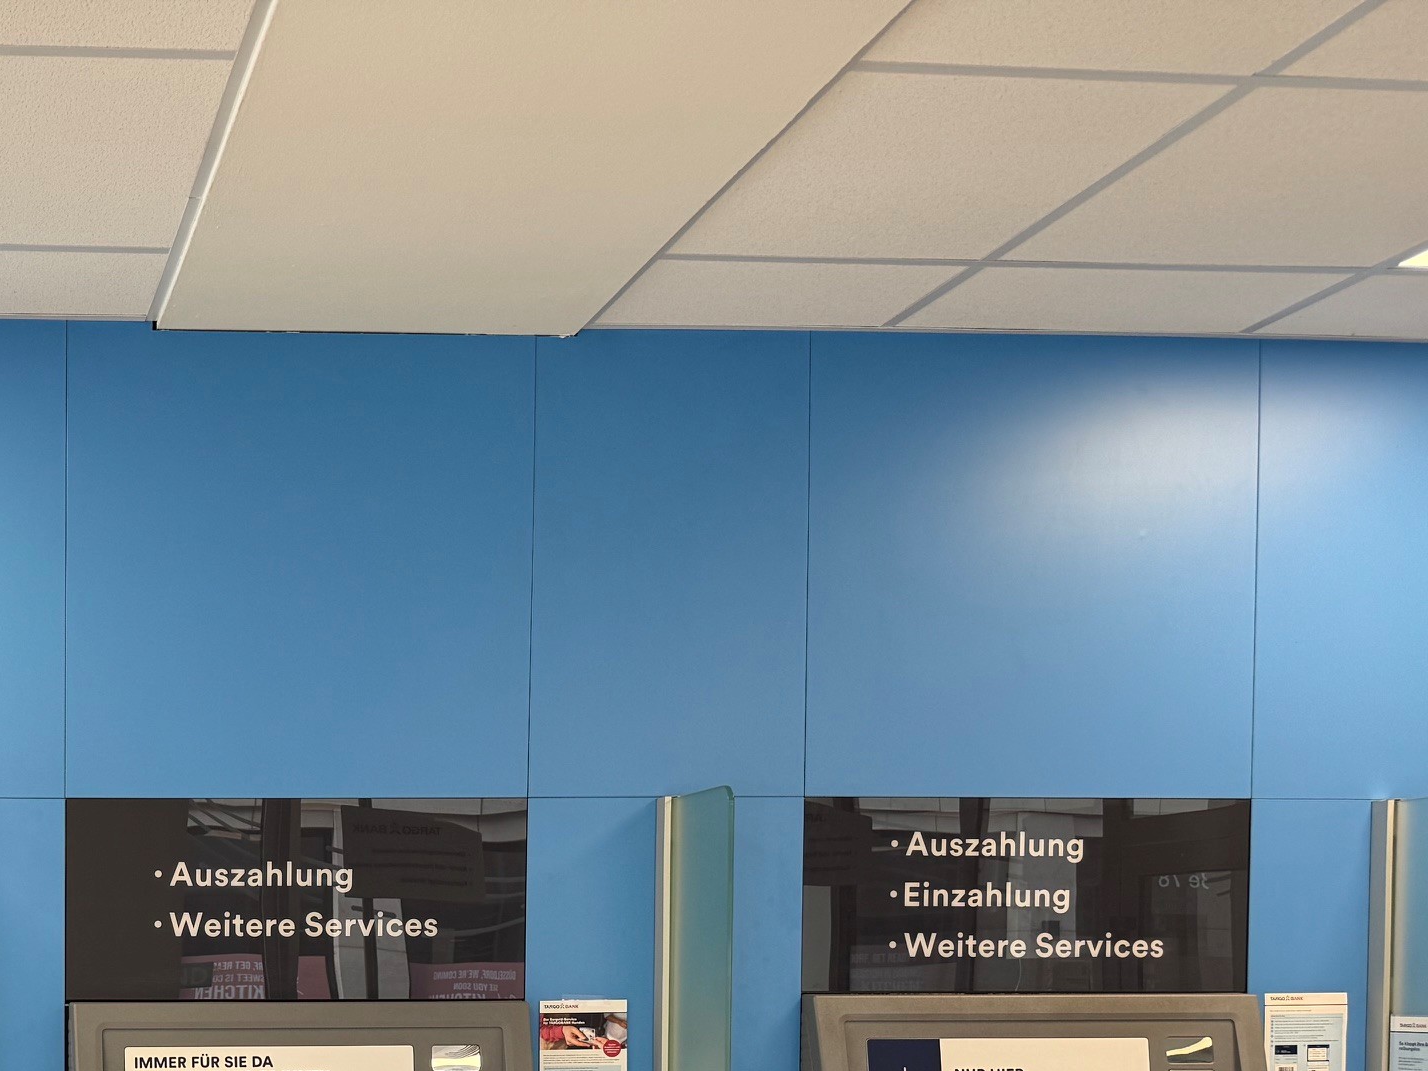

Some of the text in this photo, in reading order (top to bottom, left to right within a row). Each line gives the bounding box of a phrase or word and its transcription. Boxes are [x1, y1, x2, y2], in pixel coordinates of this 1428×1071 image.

[905, 831, 1084, 864] Auszahlung
[169, 861, 353, 894] Auszahlung
[904, 881, 1070, 914] Einzahlung
[169, 911, 438, 938] Weitere Services
[904, 932, 1164, 958] Weitere Services
[134, 1053, 274, 1069] IMMER FÜR SIE DA
